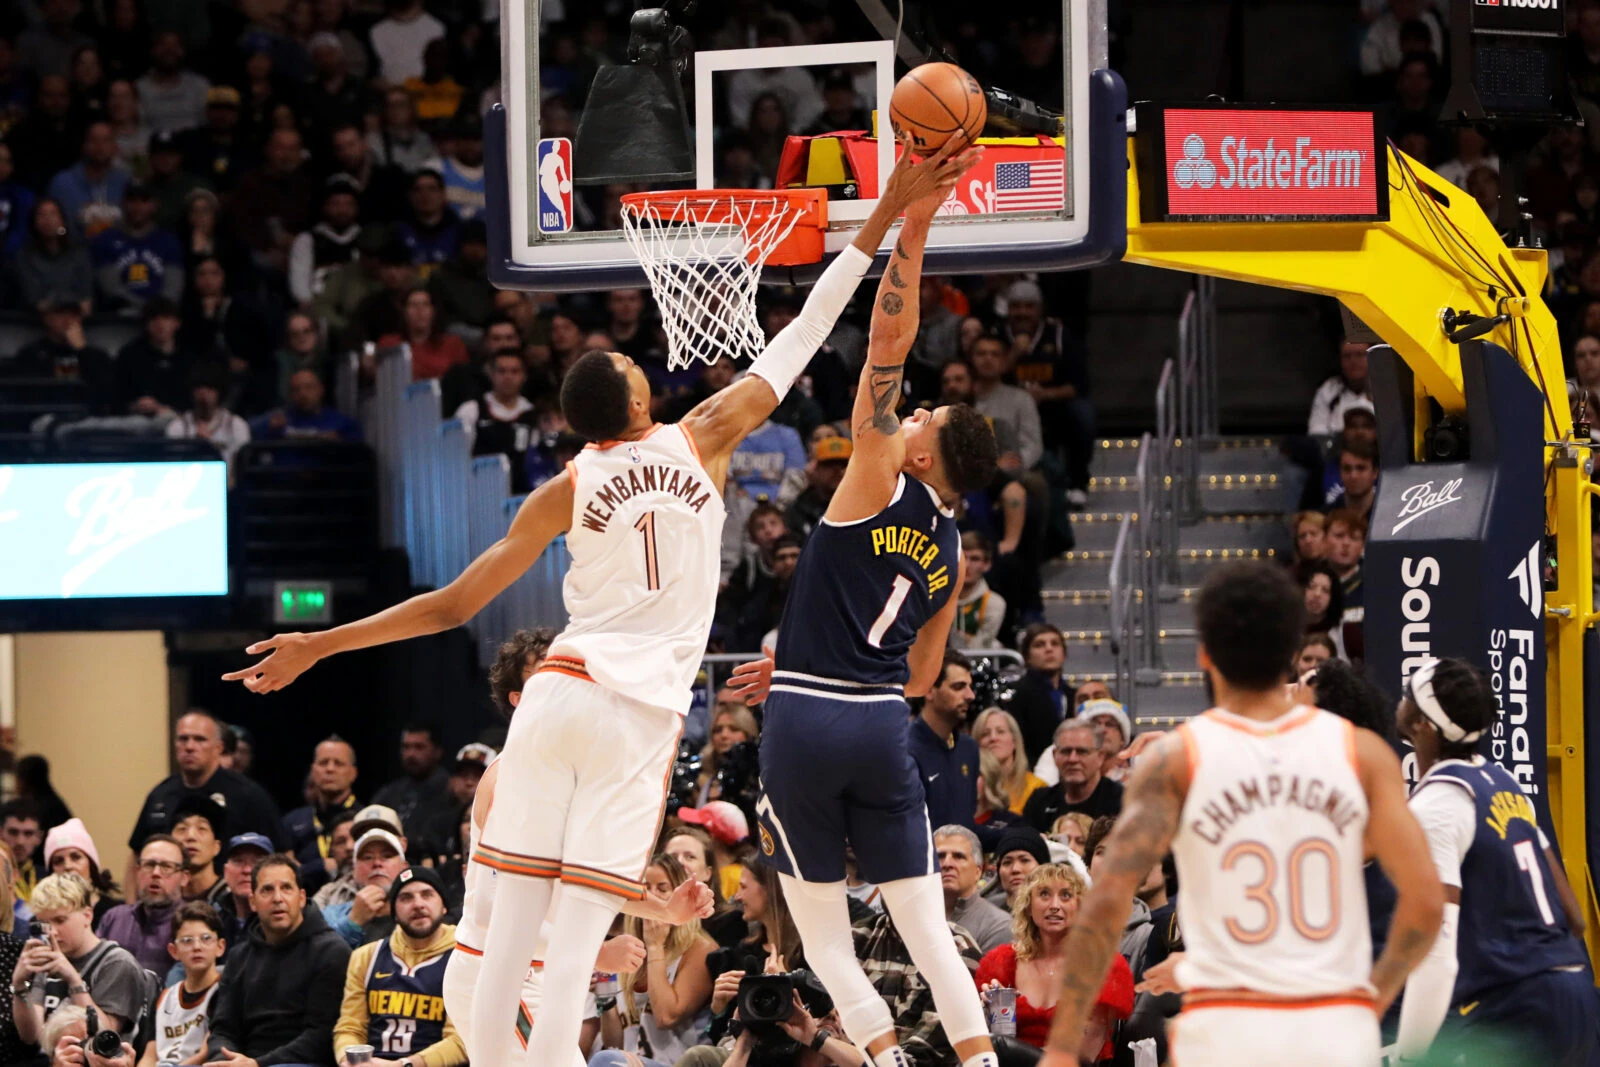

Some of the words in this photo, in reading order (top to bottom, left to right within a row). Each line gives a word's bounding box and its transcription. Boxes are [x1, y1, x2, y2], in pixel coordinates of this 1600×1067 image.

[542, 212, 560, 228] NBA
[582, 465, 711, 534] WEMBANYAMA
[1392, 477, 1464, 536] Ball
[634, 511, 660, 591] 1
[871, 525, 940, 570] PORTER
[927, 565, 949, 600] JR.
[867, 573, 913, 649] 1
[1220, 837, 1342, 945] 30
[1513, 839, 1556, 926] 7
[368, 989, 445, 1021] DENVER
[381, 1018, 417, 1053] 15
